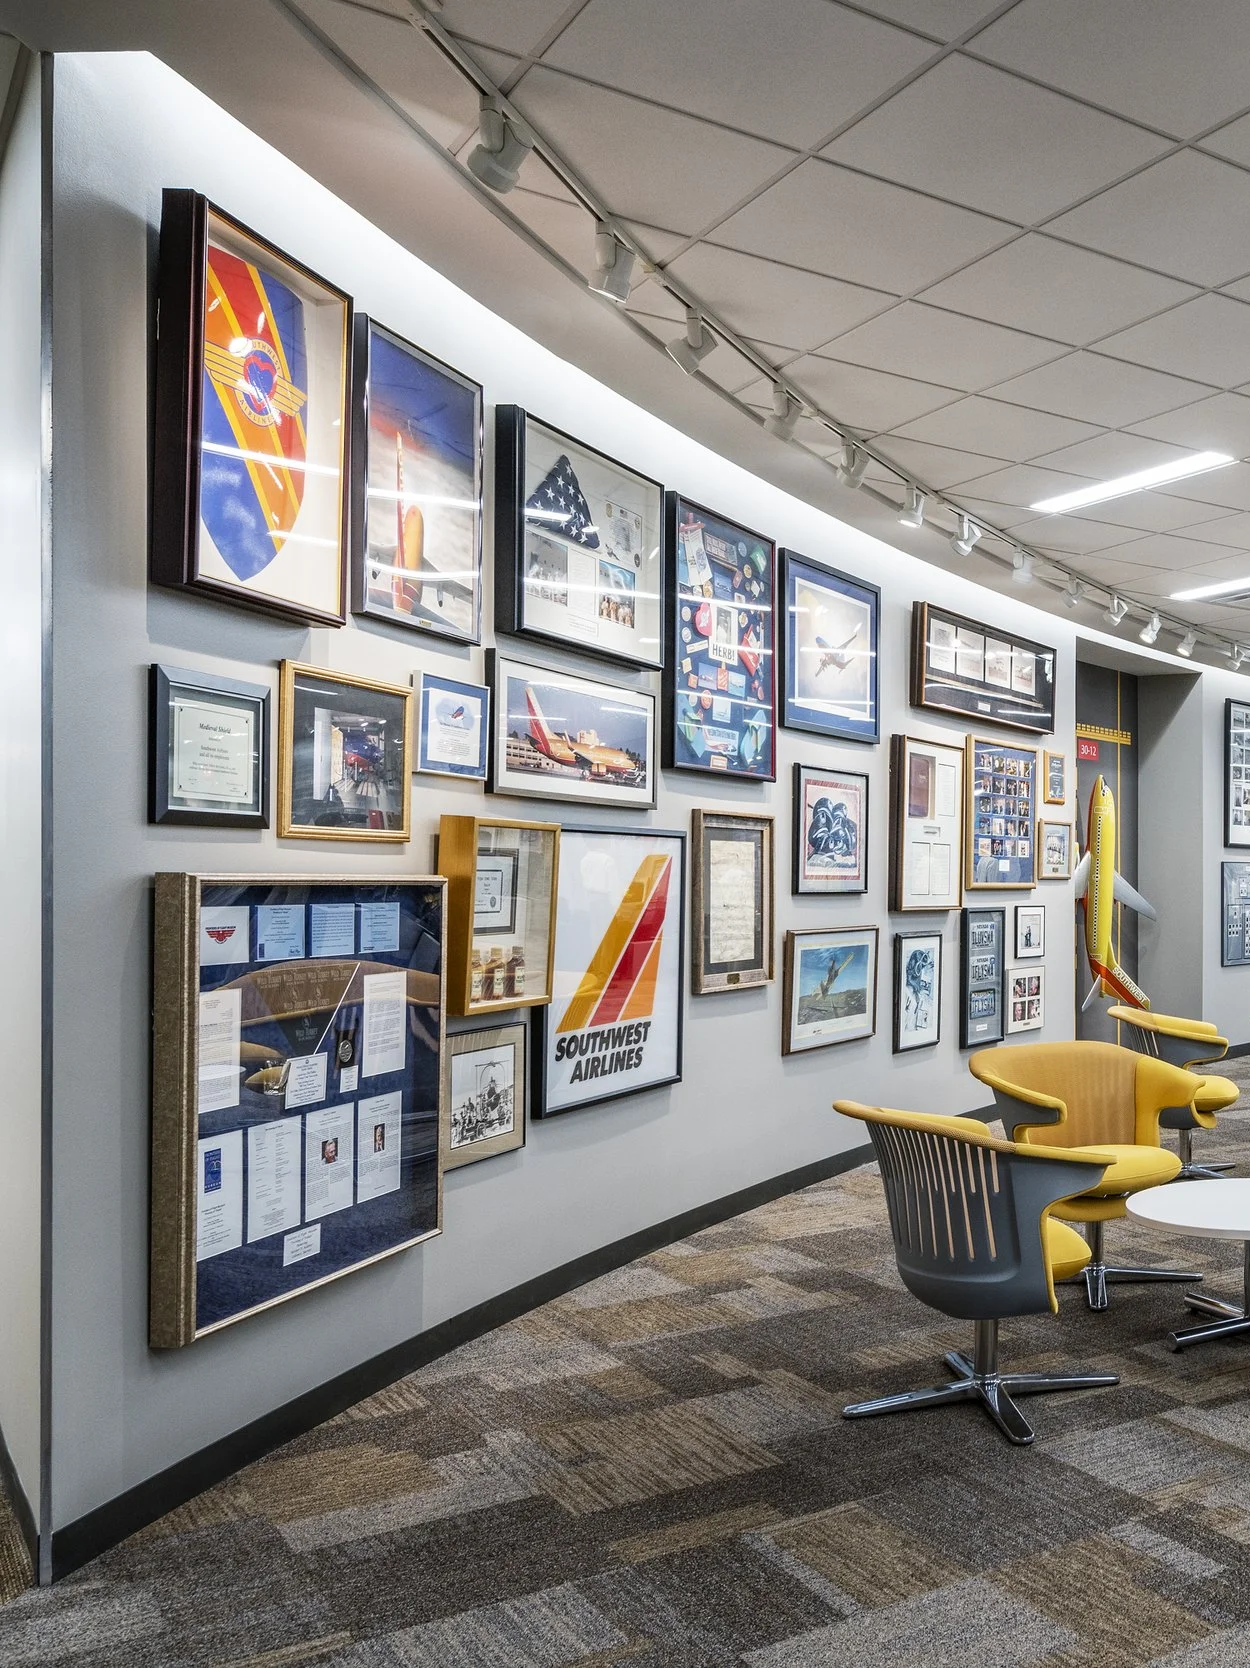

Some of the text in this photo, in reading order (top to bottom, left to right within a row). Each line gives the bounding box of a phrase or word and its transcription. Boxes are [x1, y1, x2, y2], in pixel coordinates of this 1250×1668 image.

[239, 399, 276, 424] AIRLINE
[712, 643, 735, 661] HERB!
[1080, 744, 1097, 757] 30-12
[1112, 966, 1147, 1003] SOUTHWEST
[555, 1021, 652, 1062] SOUTHWEST
[569, 1047, 644, 1084] AIRLINES
